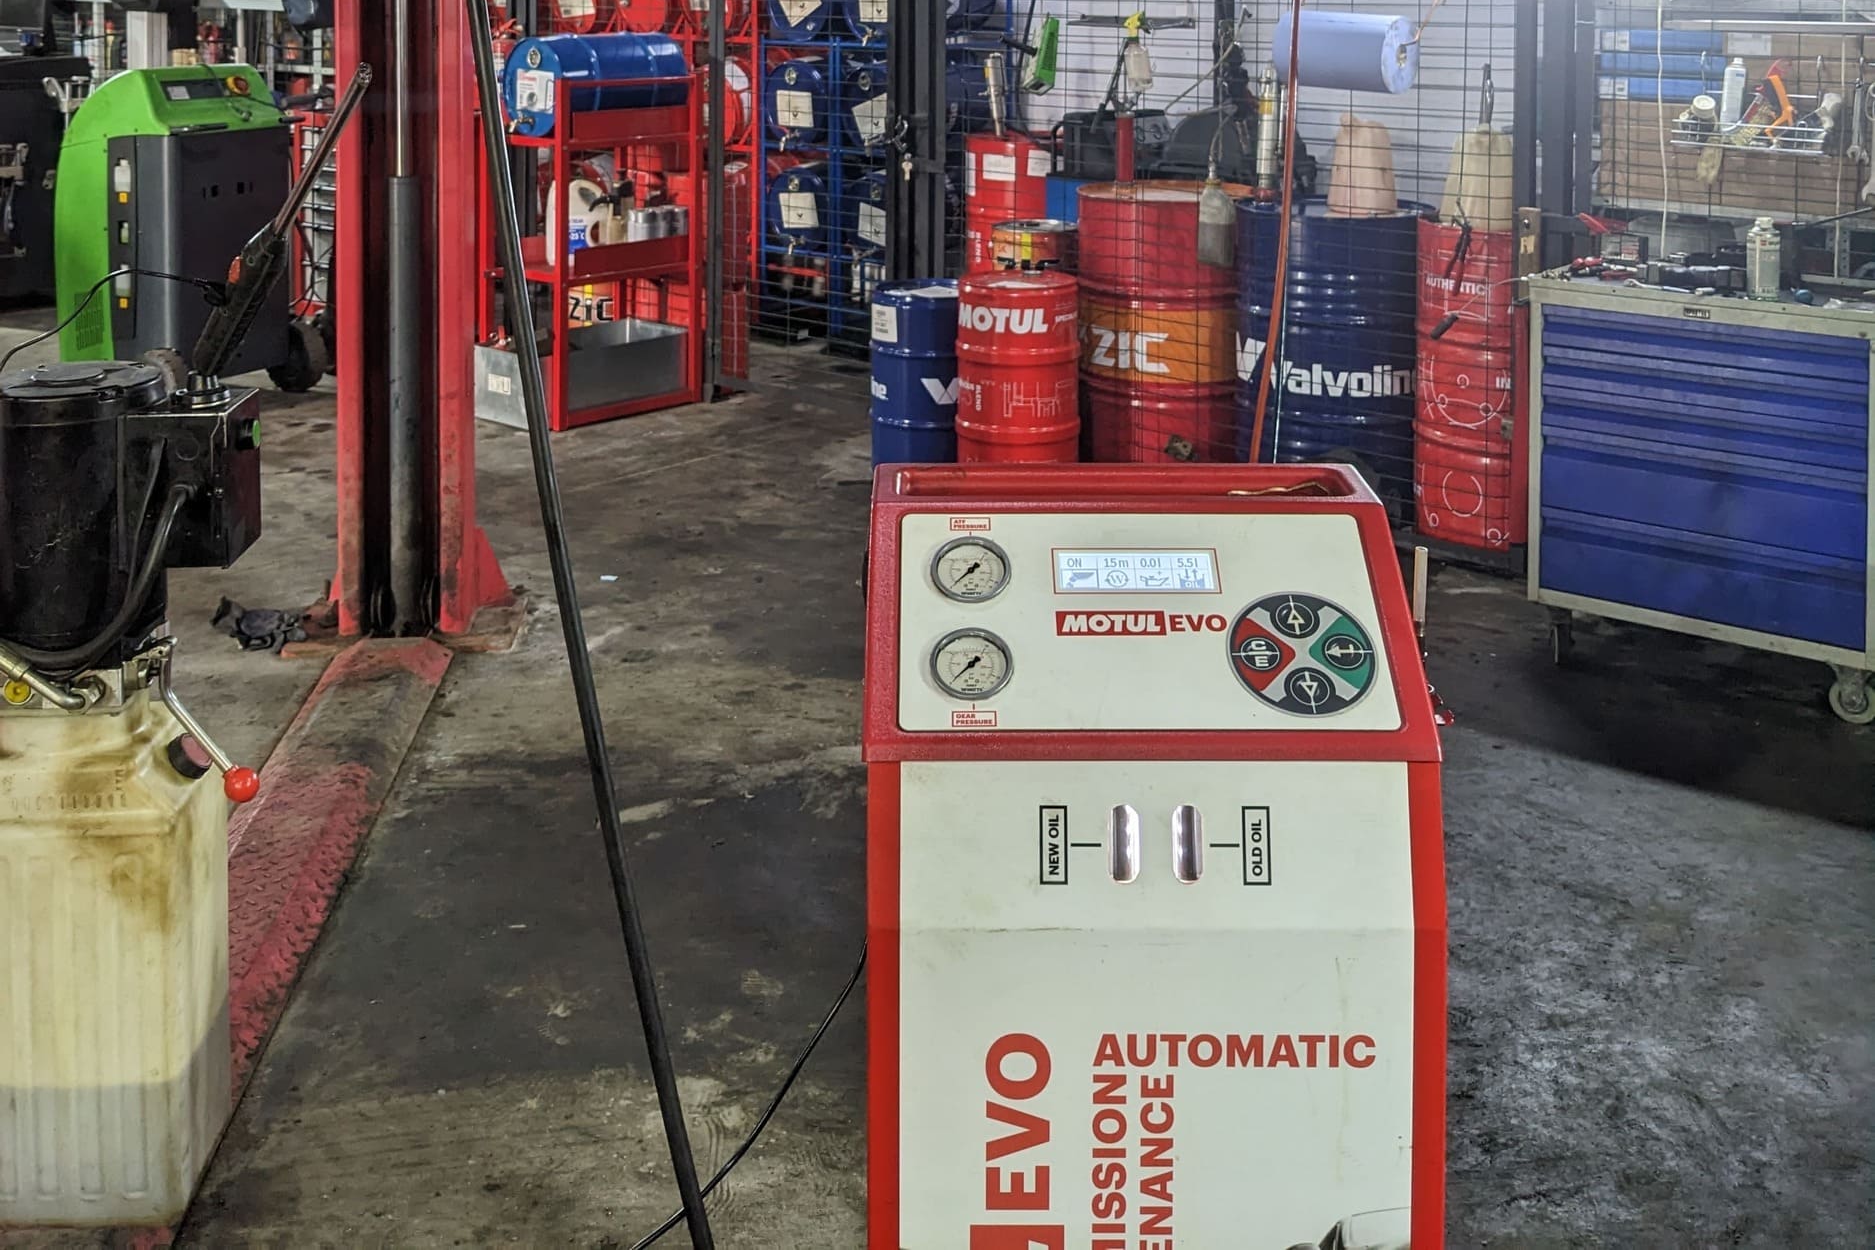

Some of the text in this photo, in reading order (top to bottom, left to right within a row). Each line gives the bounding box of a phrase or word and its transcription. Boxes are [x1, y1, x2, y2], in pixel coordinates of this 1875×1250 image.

[958, 302, 1048, 335] MOTUL
[1091, 324, 1171, 374] ZIC
[1067, 558, 1082, 568] ON
[1062, 614, 1227, 633] MOTUL EVO
[1048, 814, 1060, 875] NEW OIL
[1251, 819, 1264, 877] OLD OIL
[1093, 1033, 1377, 1068] AUTOMATIC
[985, 1033, 1051, 1211] EVO
